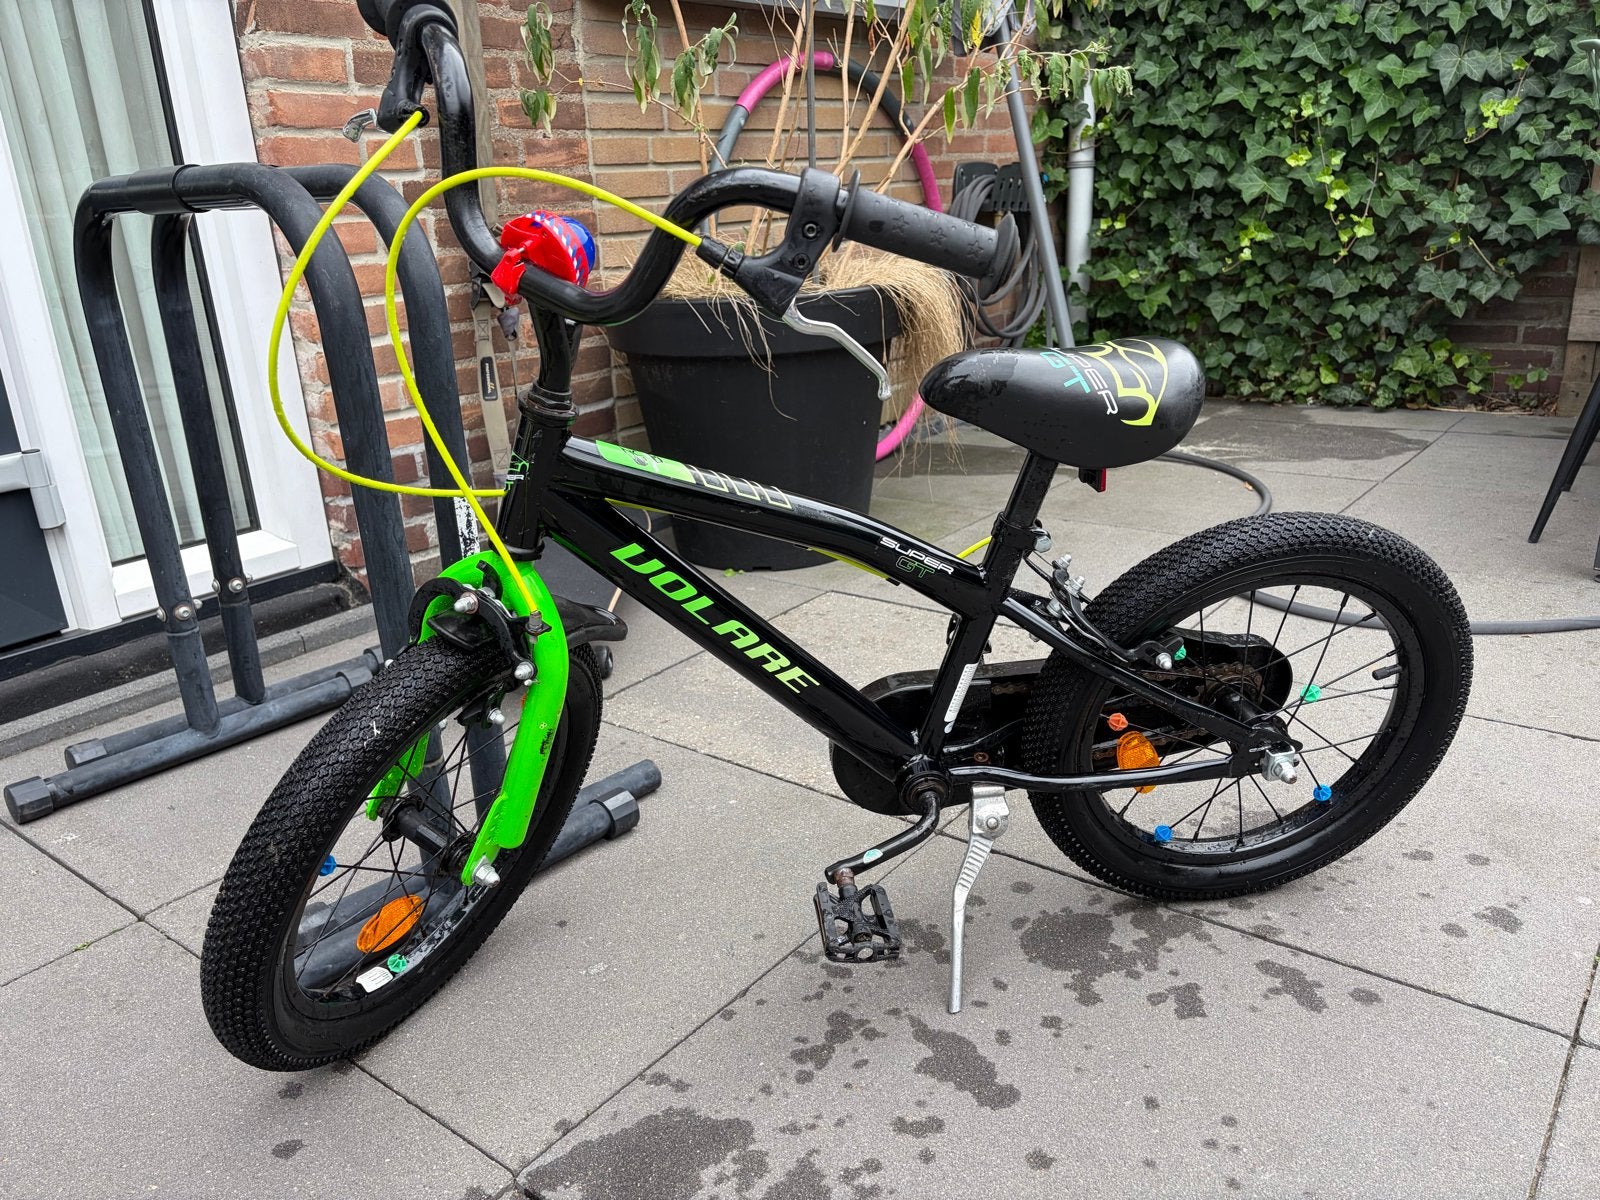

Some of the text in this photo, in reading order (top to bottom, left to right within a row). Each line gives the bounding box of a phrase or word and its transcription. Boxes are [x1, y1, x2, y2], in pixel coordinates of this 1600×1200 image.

[1039, 351, 1091, 394] GT
[1048, 347, 1119, 415] UPER
[880, 536, 955, 575] SUPER
[895, 555, 936, 579] GT
[609, 542, 821, 694] VOLARE
